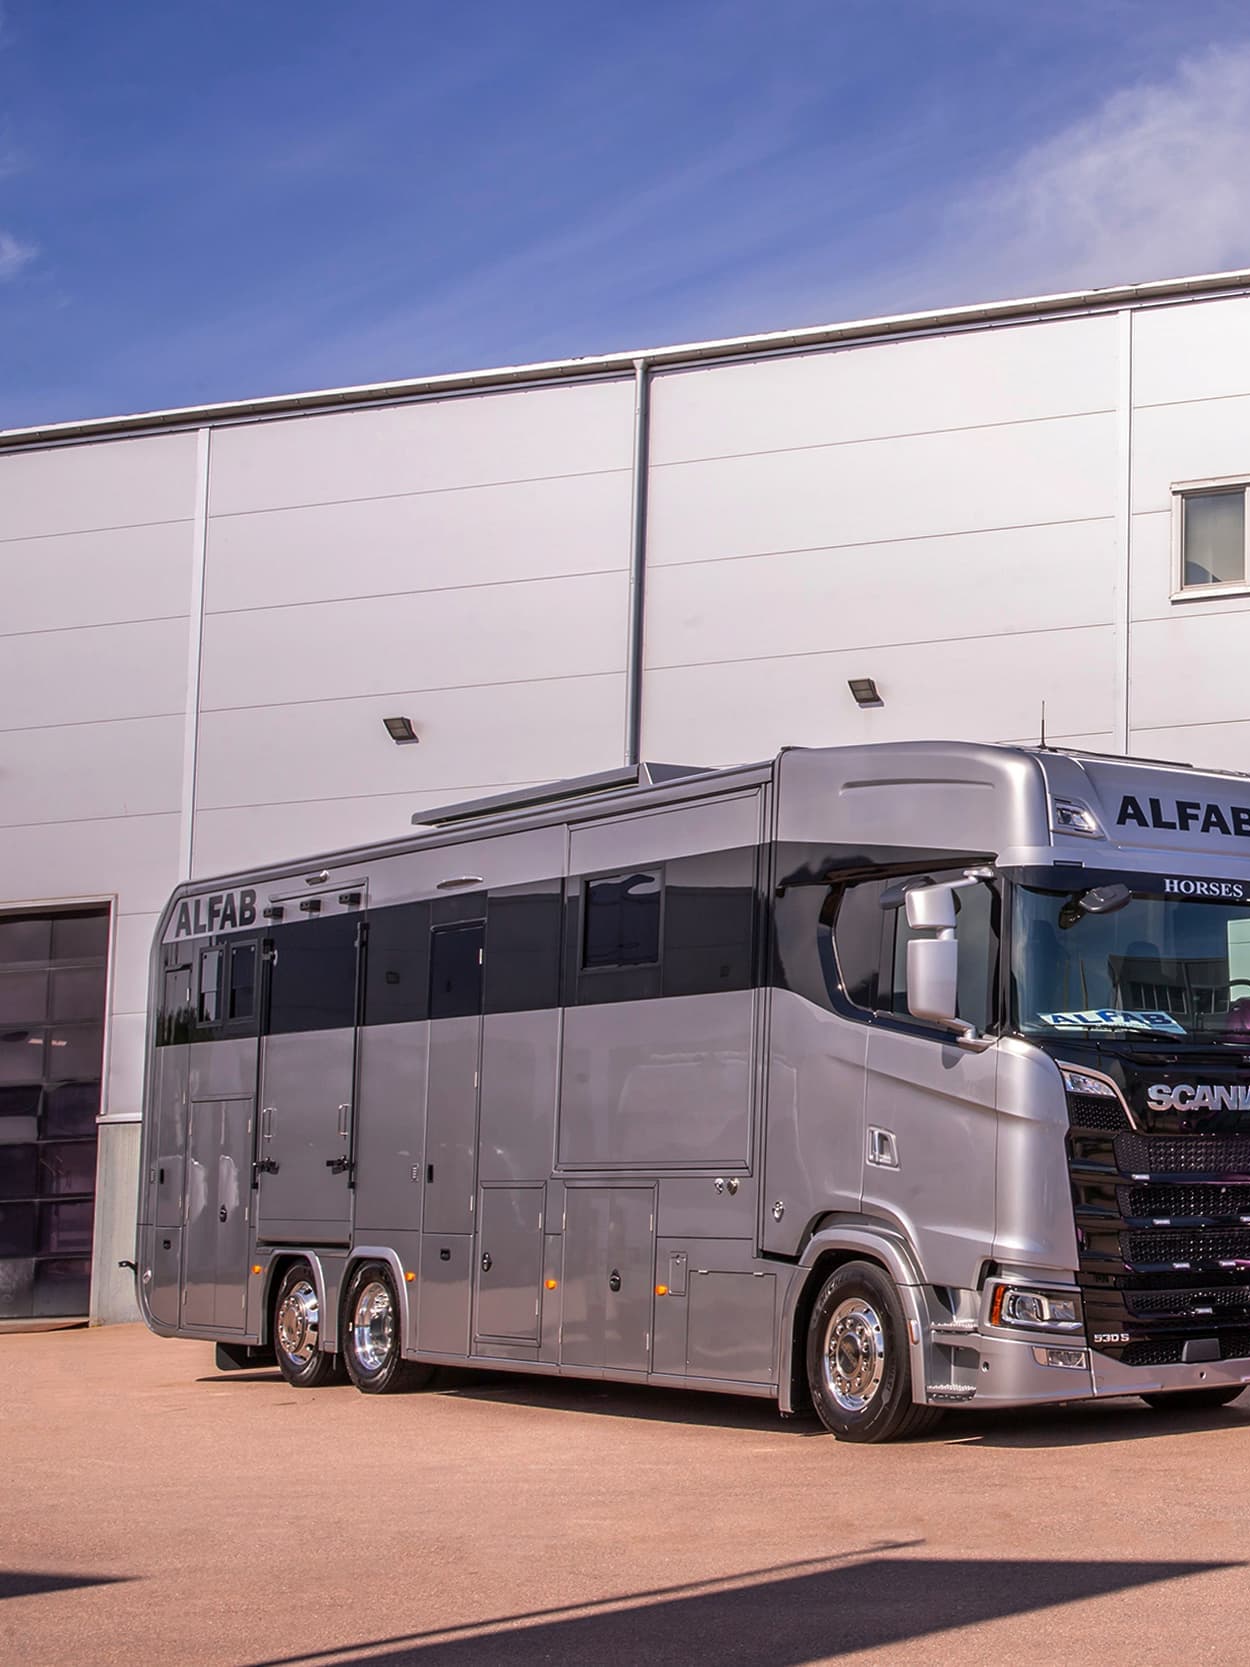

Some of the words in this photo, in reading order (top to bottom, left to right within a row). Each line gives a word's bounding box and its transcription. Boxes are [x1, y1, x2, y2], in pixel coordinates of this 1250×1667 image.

[1163, 878, 1244, 898] HORSES
[174, 889, 257, 938] ALFAB
[1050, 1009, 1173, 1026] ALFAB
